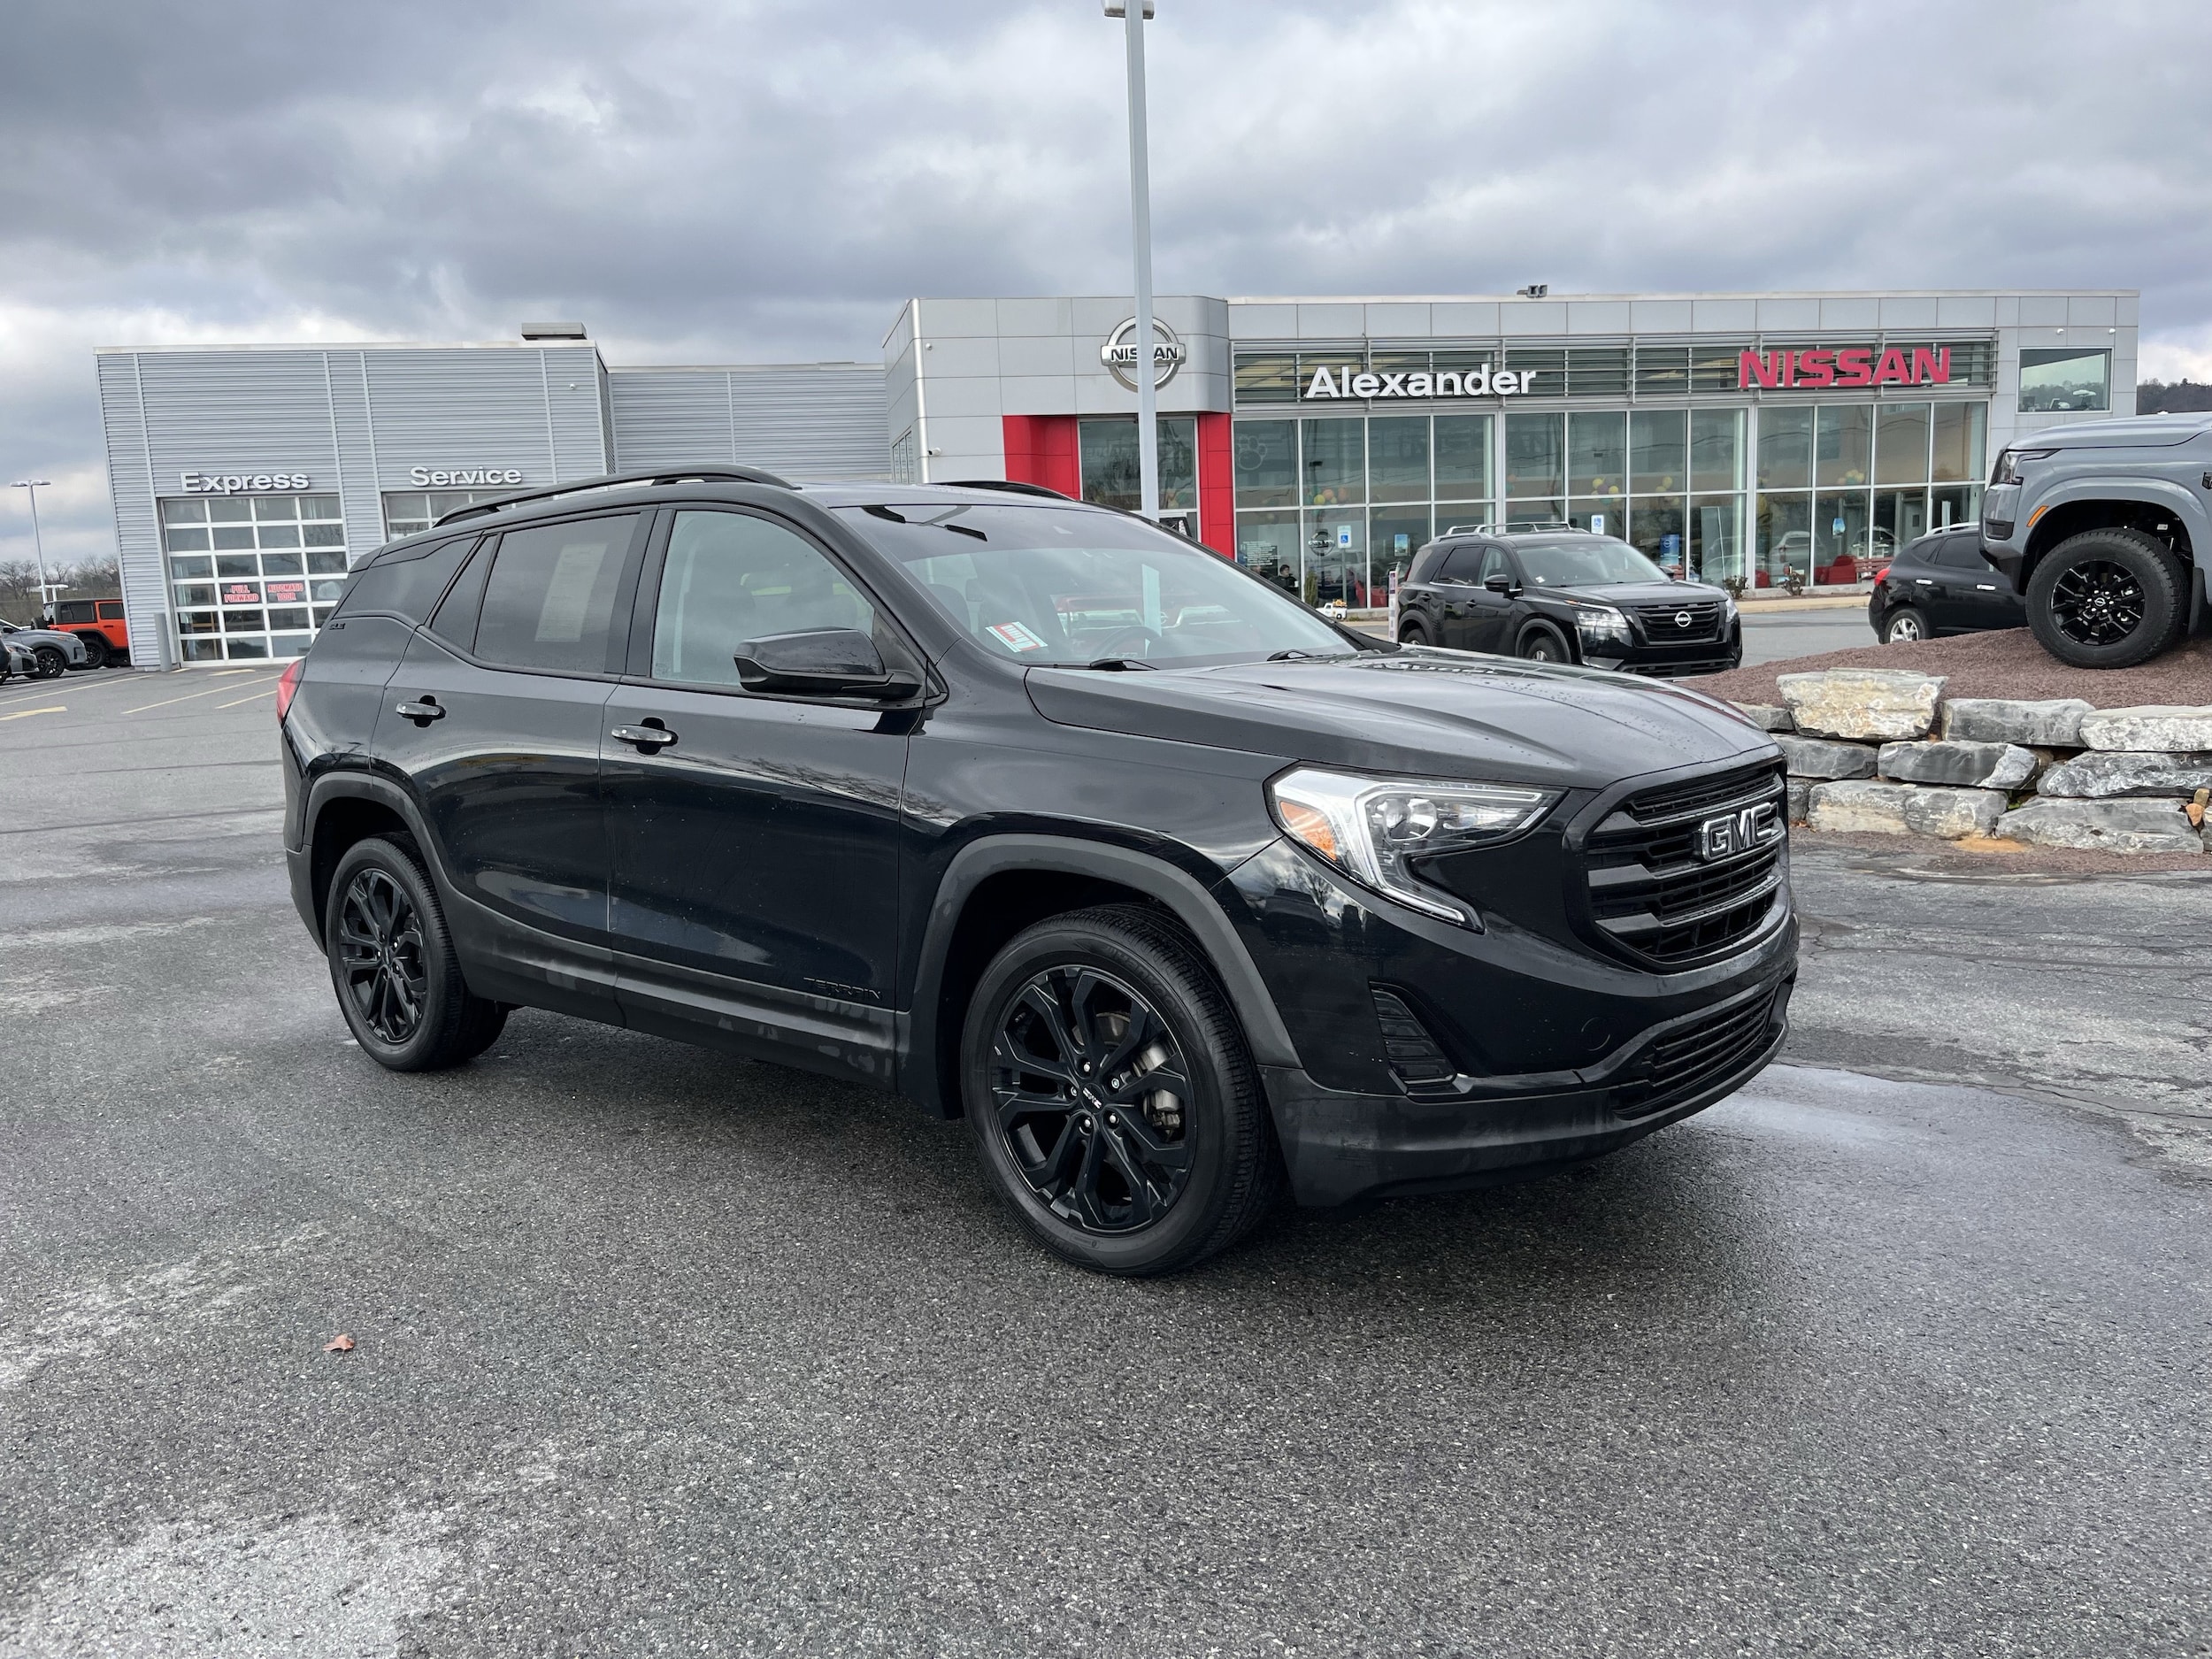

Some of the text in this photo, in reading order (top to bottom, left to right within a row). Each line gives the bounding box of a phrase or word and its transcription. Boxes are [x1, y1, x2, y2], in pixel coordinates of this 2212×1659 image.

[1110, 346, 1179, 362] NISAN
[1738, 347, 1951, 389] NISSAN
[1305, 364, 1537, 398] Alexander
[180, 472, 310, 495] Express
[409, 466, 523, 487] Service
[224, 593, 259, 603] FORWARD
[231, 584, 250, 594] PULL
[267, 583, 303, 593] AUTOMATIC
[277, 592, 296, 601] DOOR
[1701, 801, 1778, 861] GMC
[803, 977, 881, 1000] TERRAIN
